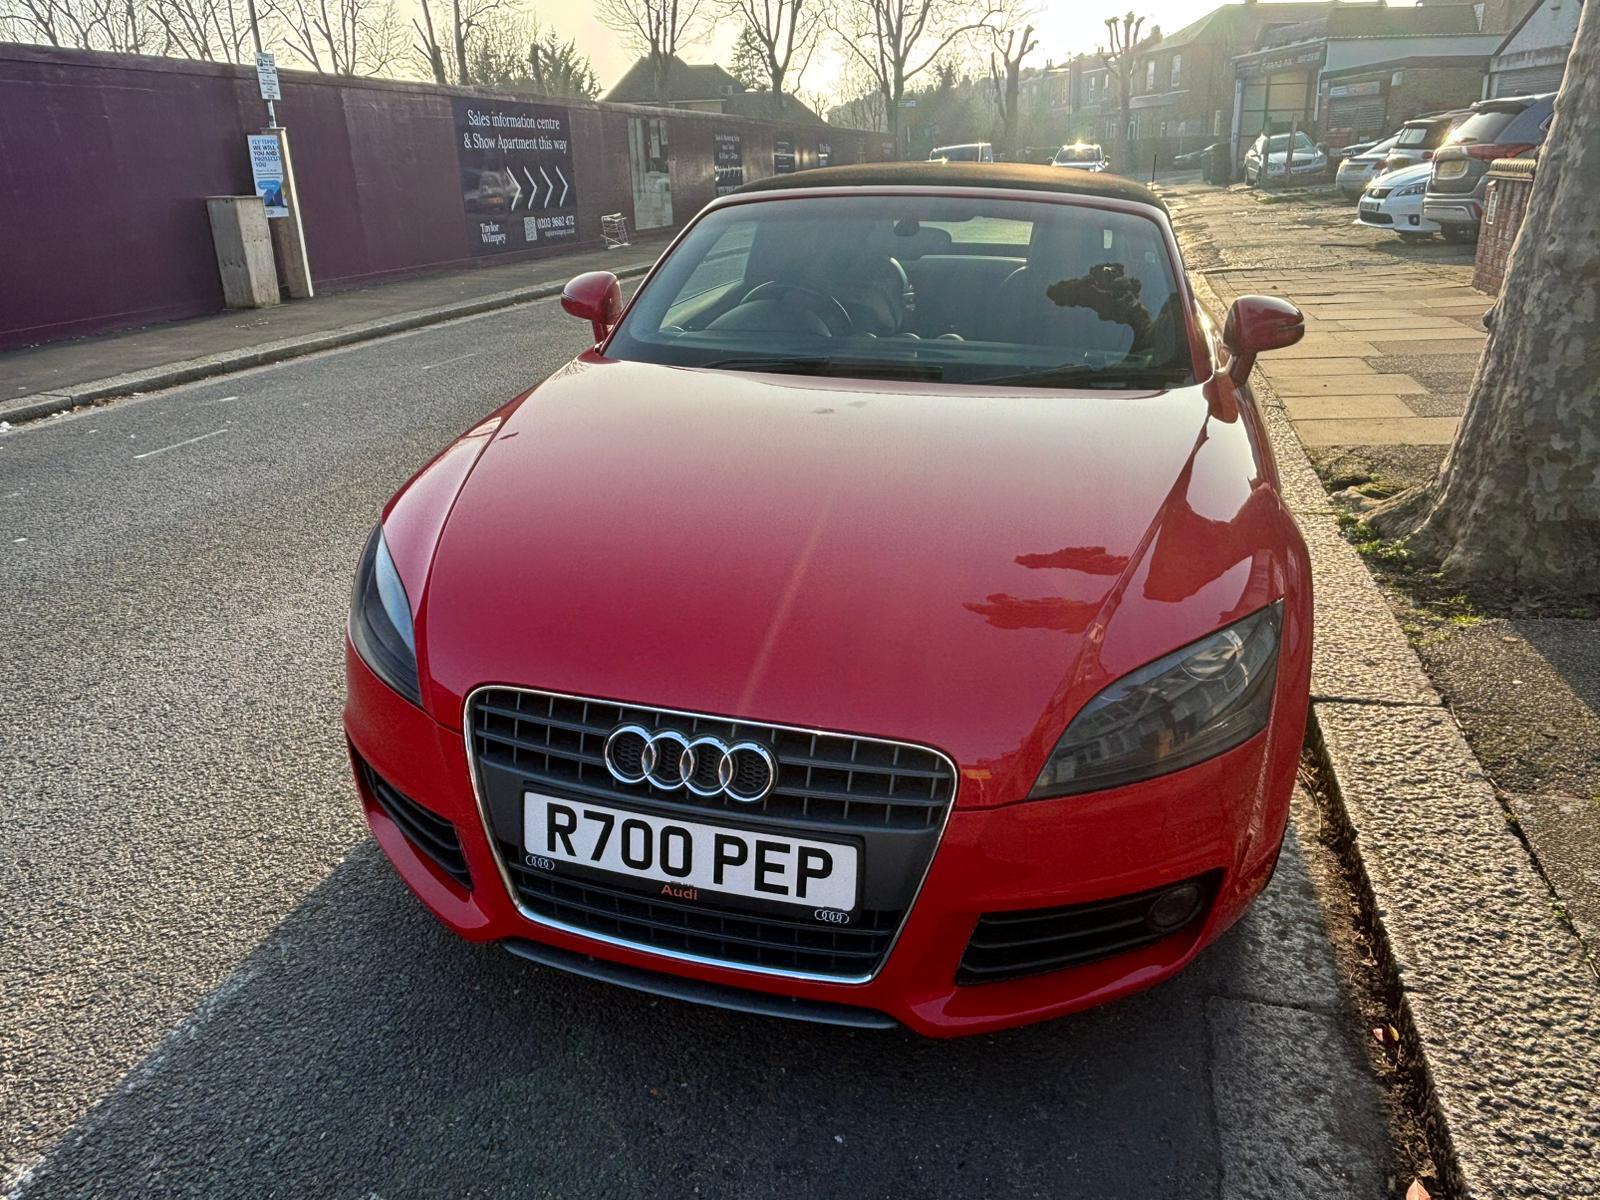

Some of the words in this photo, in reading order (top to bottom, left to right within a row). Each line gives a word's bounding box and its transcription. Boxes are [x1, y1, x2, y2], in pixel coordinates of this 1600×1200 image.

[467, 109, 491, 127] Sales
[491, 111, 536, 129] information
[536, 118, 560, 130] centre
[463, 132, 472, 149] &
[472, 132, 496, 149] Show
[497, 134, 538, 154] Apartment
[538, 135, 553, 150] this
[553, 139, 568, 155] way
[480, 221, 499, 233] Taylor
[537, 217, 551, 230] 0203
[481, 232, 506, 244] Wimpey
[546, 802, 693, 878] R700
[713, 833, 834, 899] PEP
[661, 884, 698, 900] Audi
